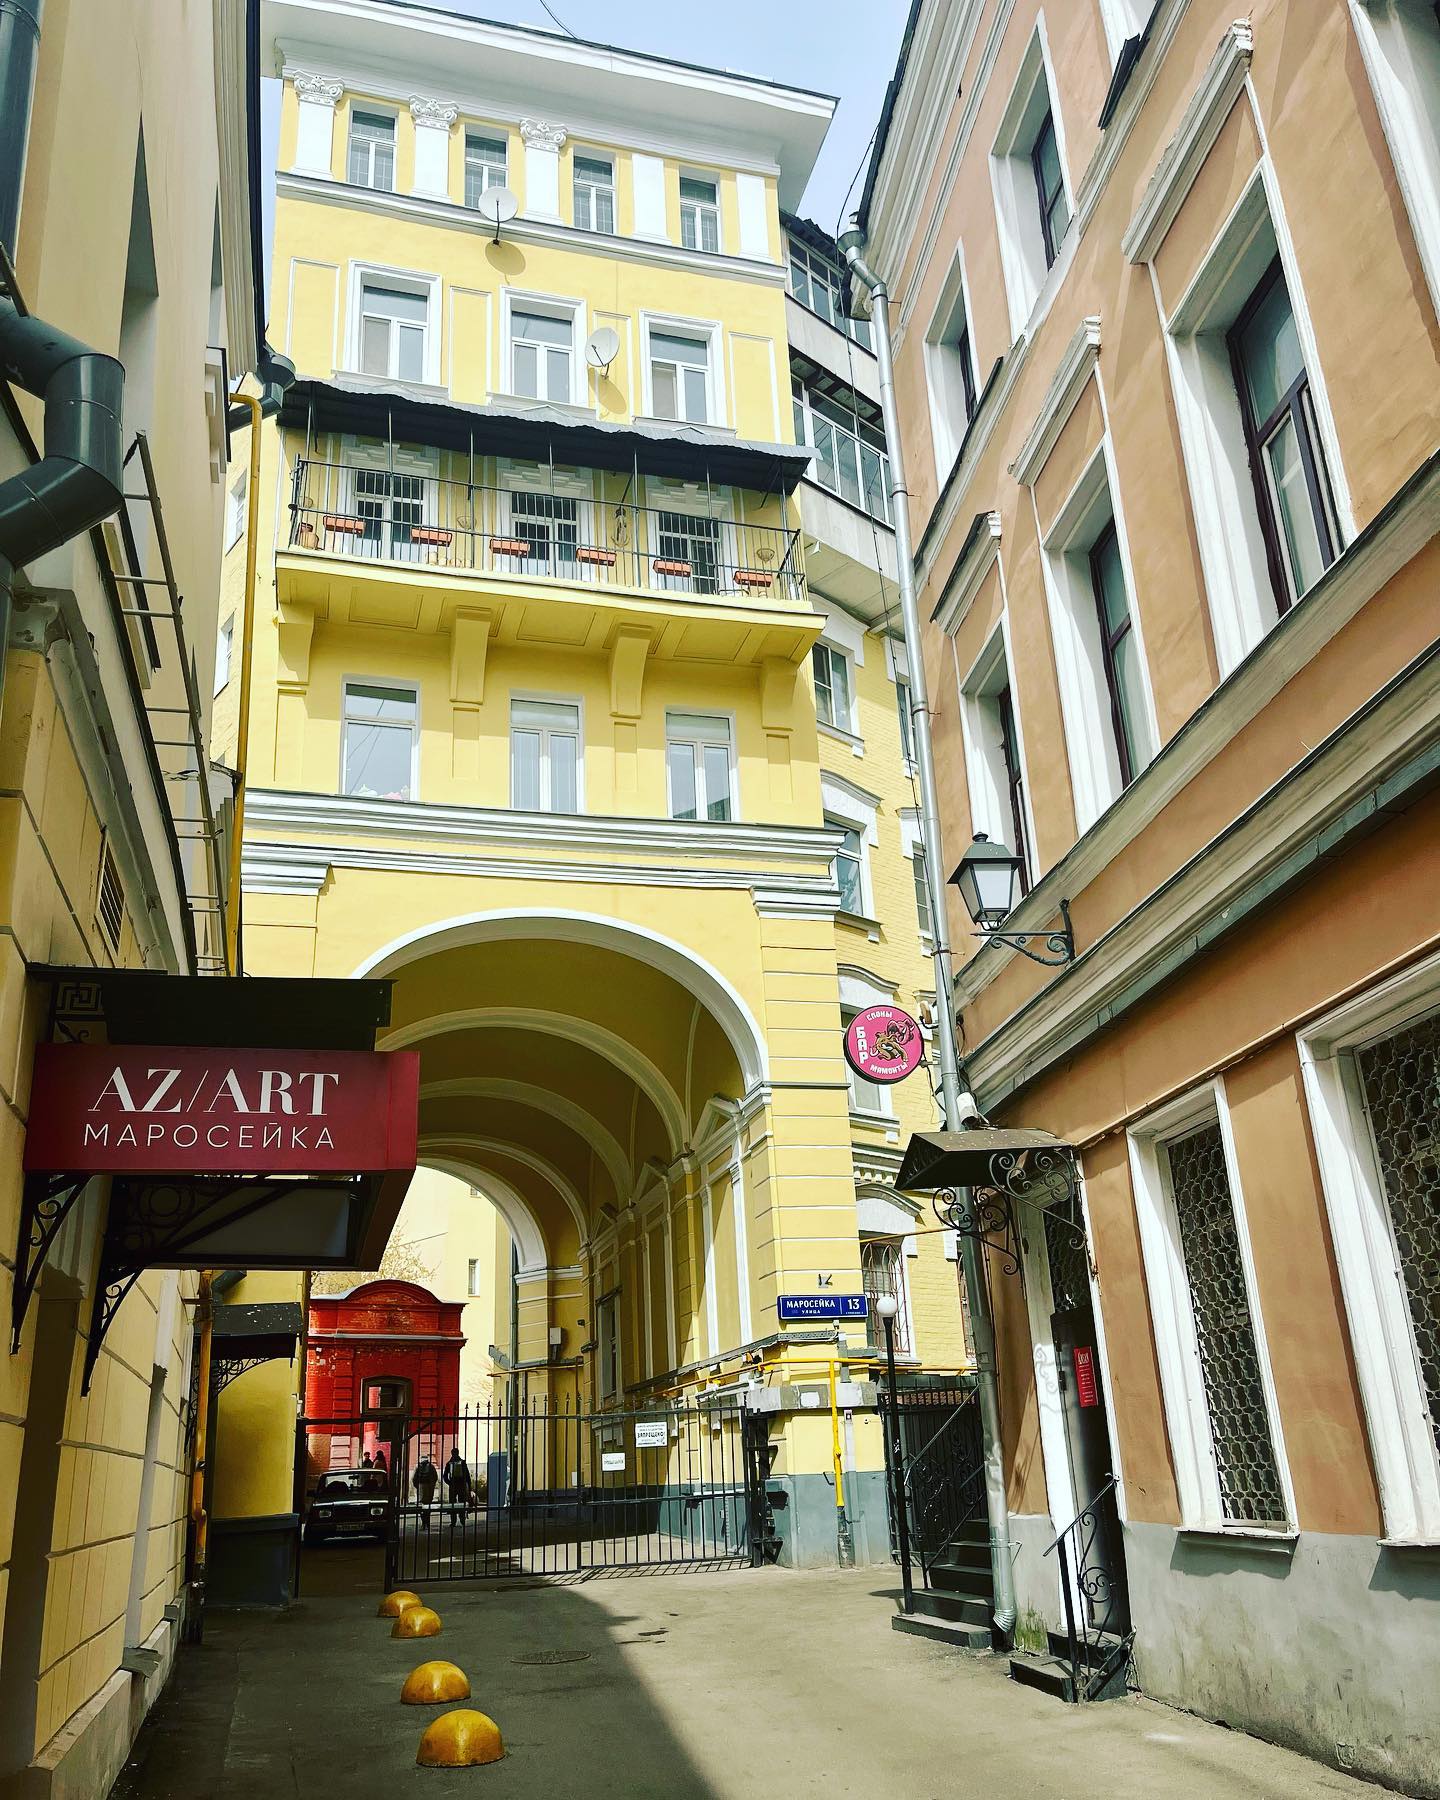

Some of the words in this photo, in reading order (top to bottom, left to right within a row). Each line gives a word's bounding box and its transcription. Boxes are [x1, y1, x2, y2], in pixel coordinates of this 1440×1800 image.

[866, 1010, 893, 1021] СЛОНЫ
[855, 1026, 869, 1064] БАР
[869, 1062, 908, 1075] МАМОНТЫ
[87, 1065, 340, 1117] AZ/ART
[83, 1121, 335, 1150] МАРОСЕЙКА
[786, 1299, 836, 1308] МАРОСЕЙКА
[847, 1298, 860, 1310] 13
